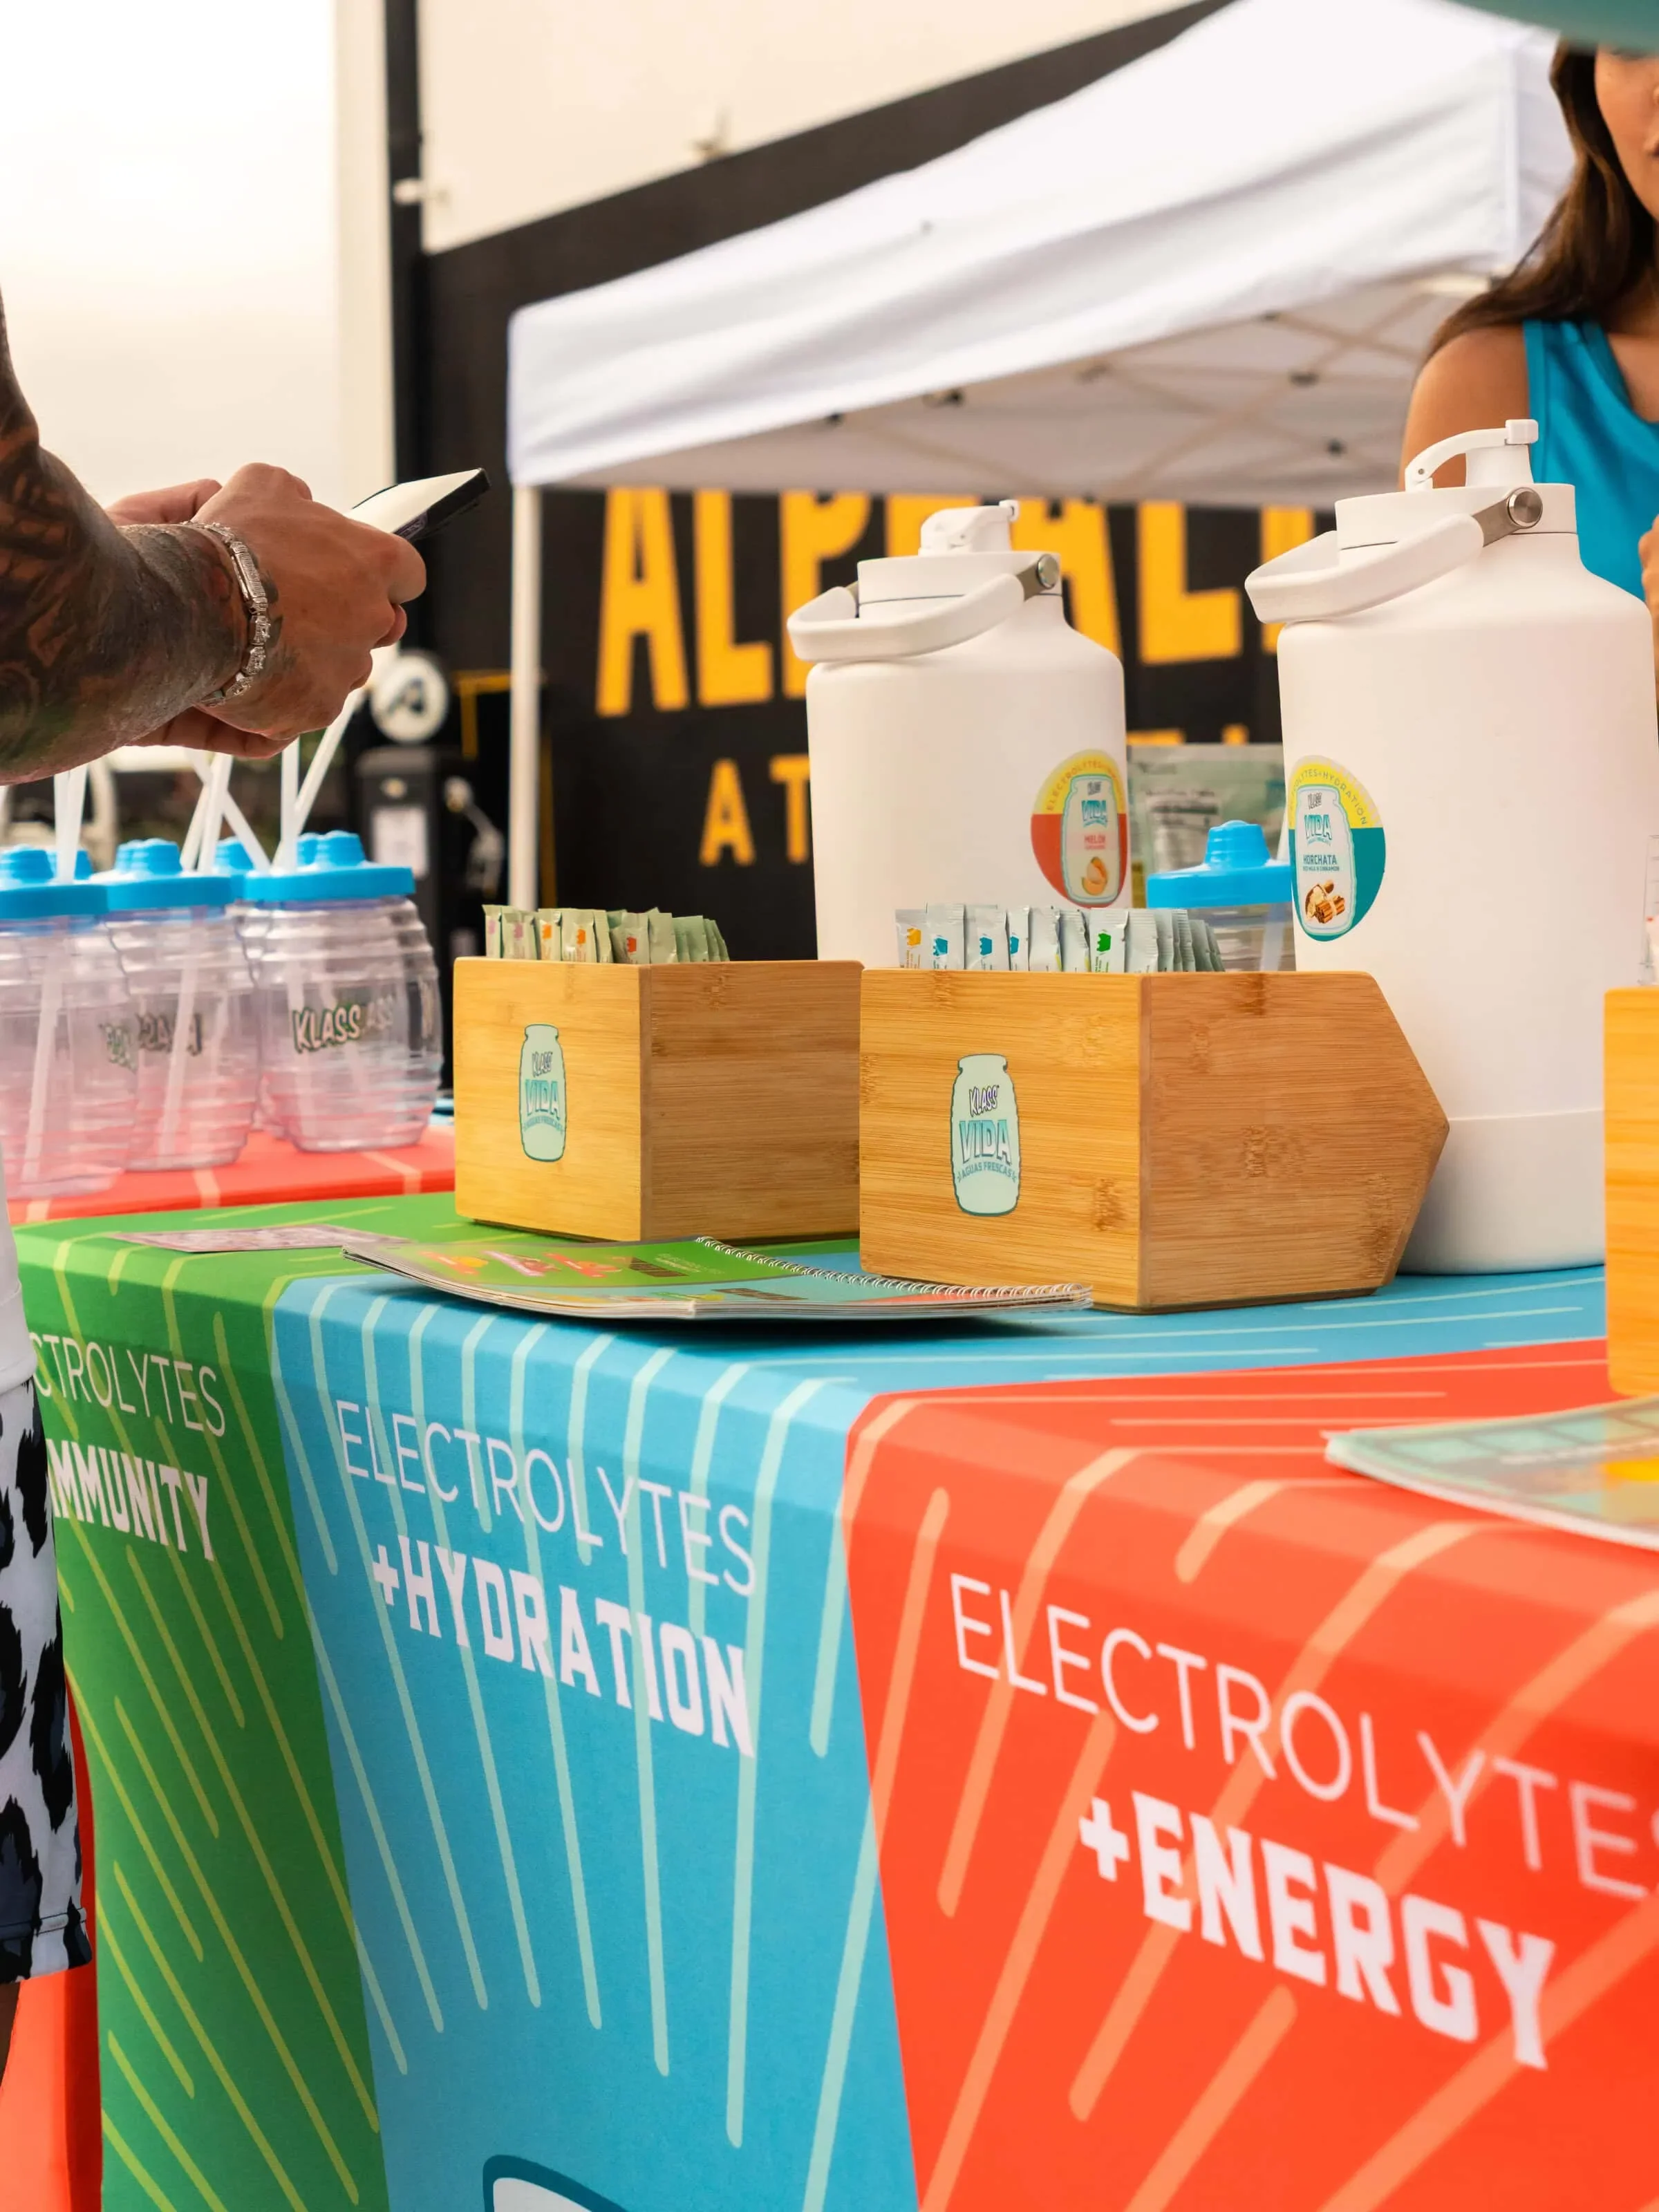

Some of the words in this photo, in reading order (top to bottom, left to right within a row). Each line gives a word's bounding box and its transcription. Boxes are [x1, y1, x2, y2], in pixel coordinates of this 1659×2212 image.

[1304, 814, 1333, 841] VIDA
[1303, 854, 1338, 865] HORCHATA
[291, 1003, 362, 1055] KLASS
[525, 1078, 561, 1121] VIDA
[969, 1084, 998, 1118] KLASS
[959, 1119, 1012, 1165] VIDA
[962, 1161, 983, 1179] AGUAS
[983, 1161, 1013, 1179] FRESCAS
[29, 1331, 226, 1438] CTROLYTES
[46, 1438, 214, 1562] MMUNITY
[336, 1400, 756, 1597] ELECTROLYTES
[372, 1535, 755, 1759] +HYDRATION
[950, 1573, 1659, 1899] ELECTROLYTE
[1078, 1790, 1555, 2070] +ENERGY
